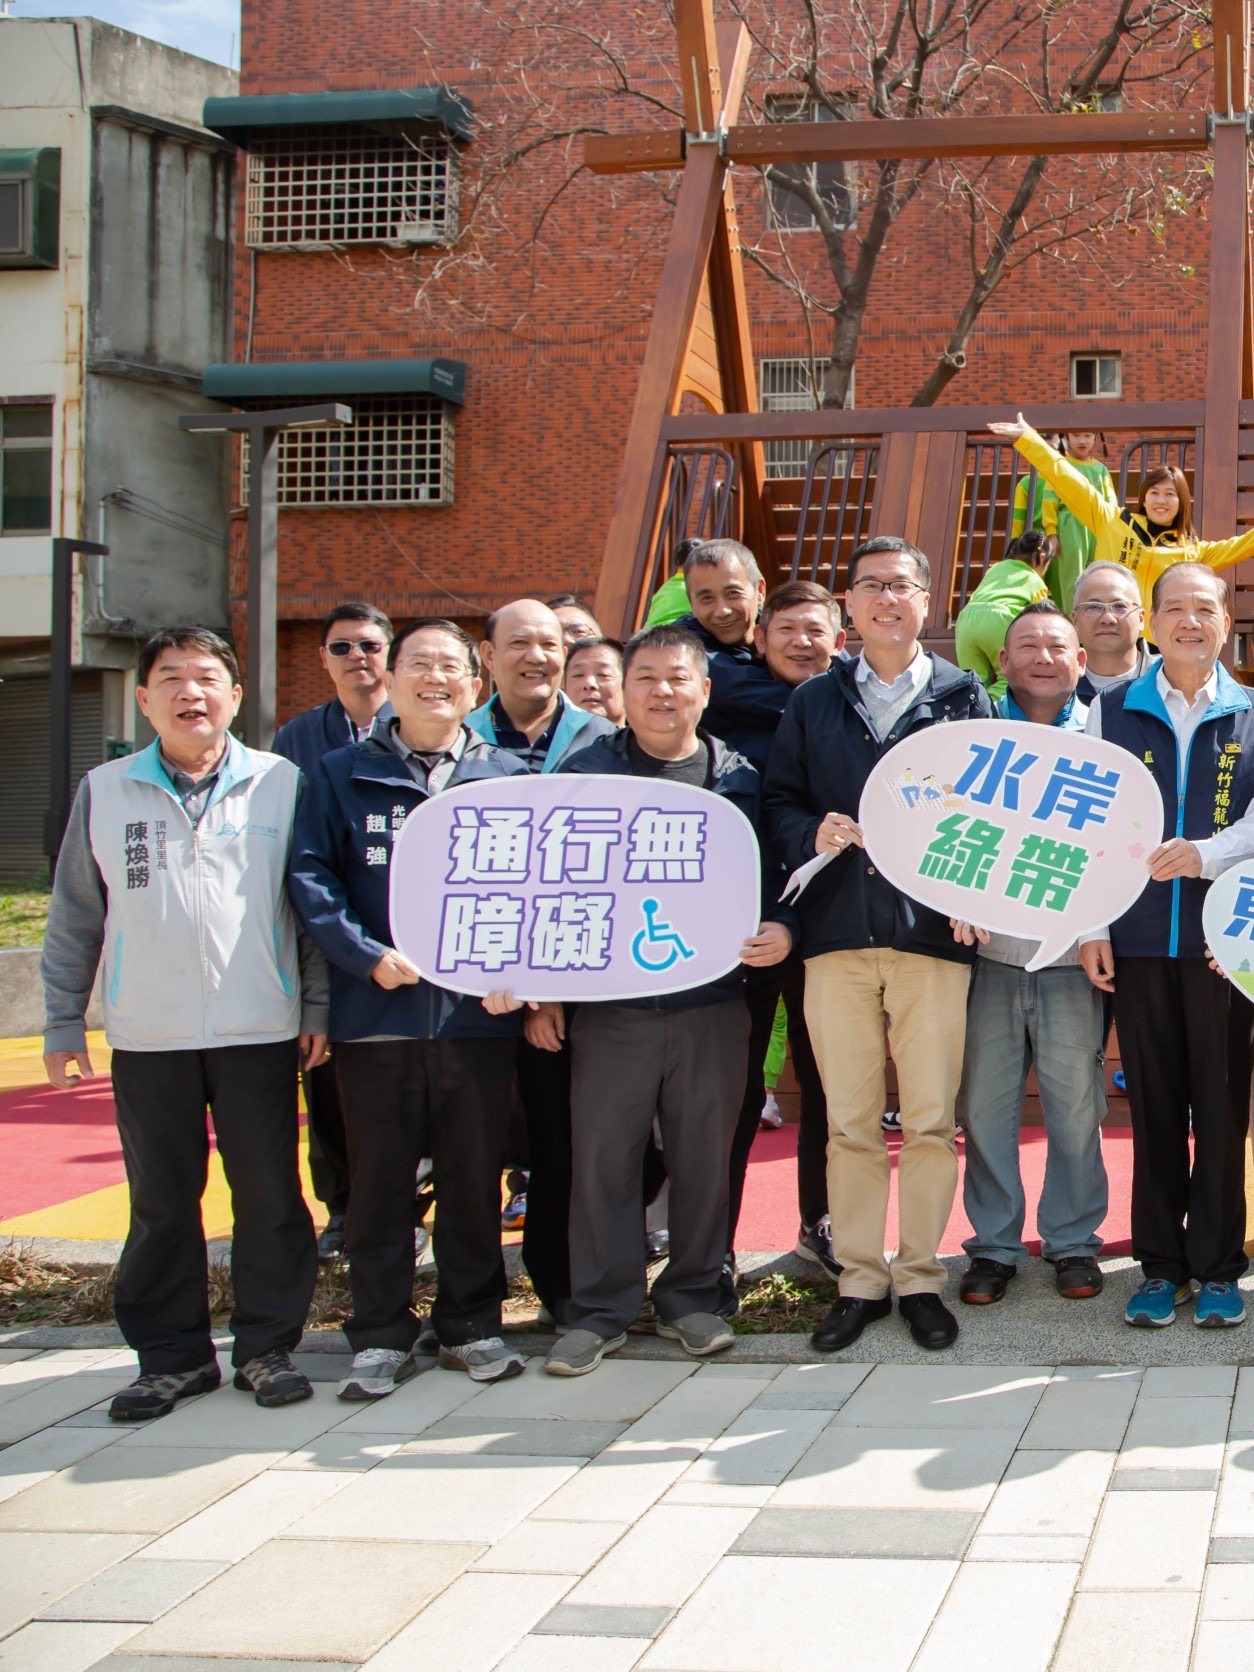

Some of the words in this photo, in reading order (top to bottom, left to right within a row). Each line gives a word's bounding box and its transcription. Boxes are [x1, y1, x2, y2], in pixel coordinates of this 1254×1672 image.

[951, 737, 1122, 832] 水岸
[155, 820, 167, 870] 頂竹里里長
[445, 806, 707, 884] 通行無
[917, 812, 1091, 913] 綠帶
[435, 892, 615, 973] 障礙
